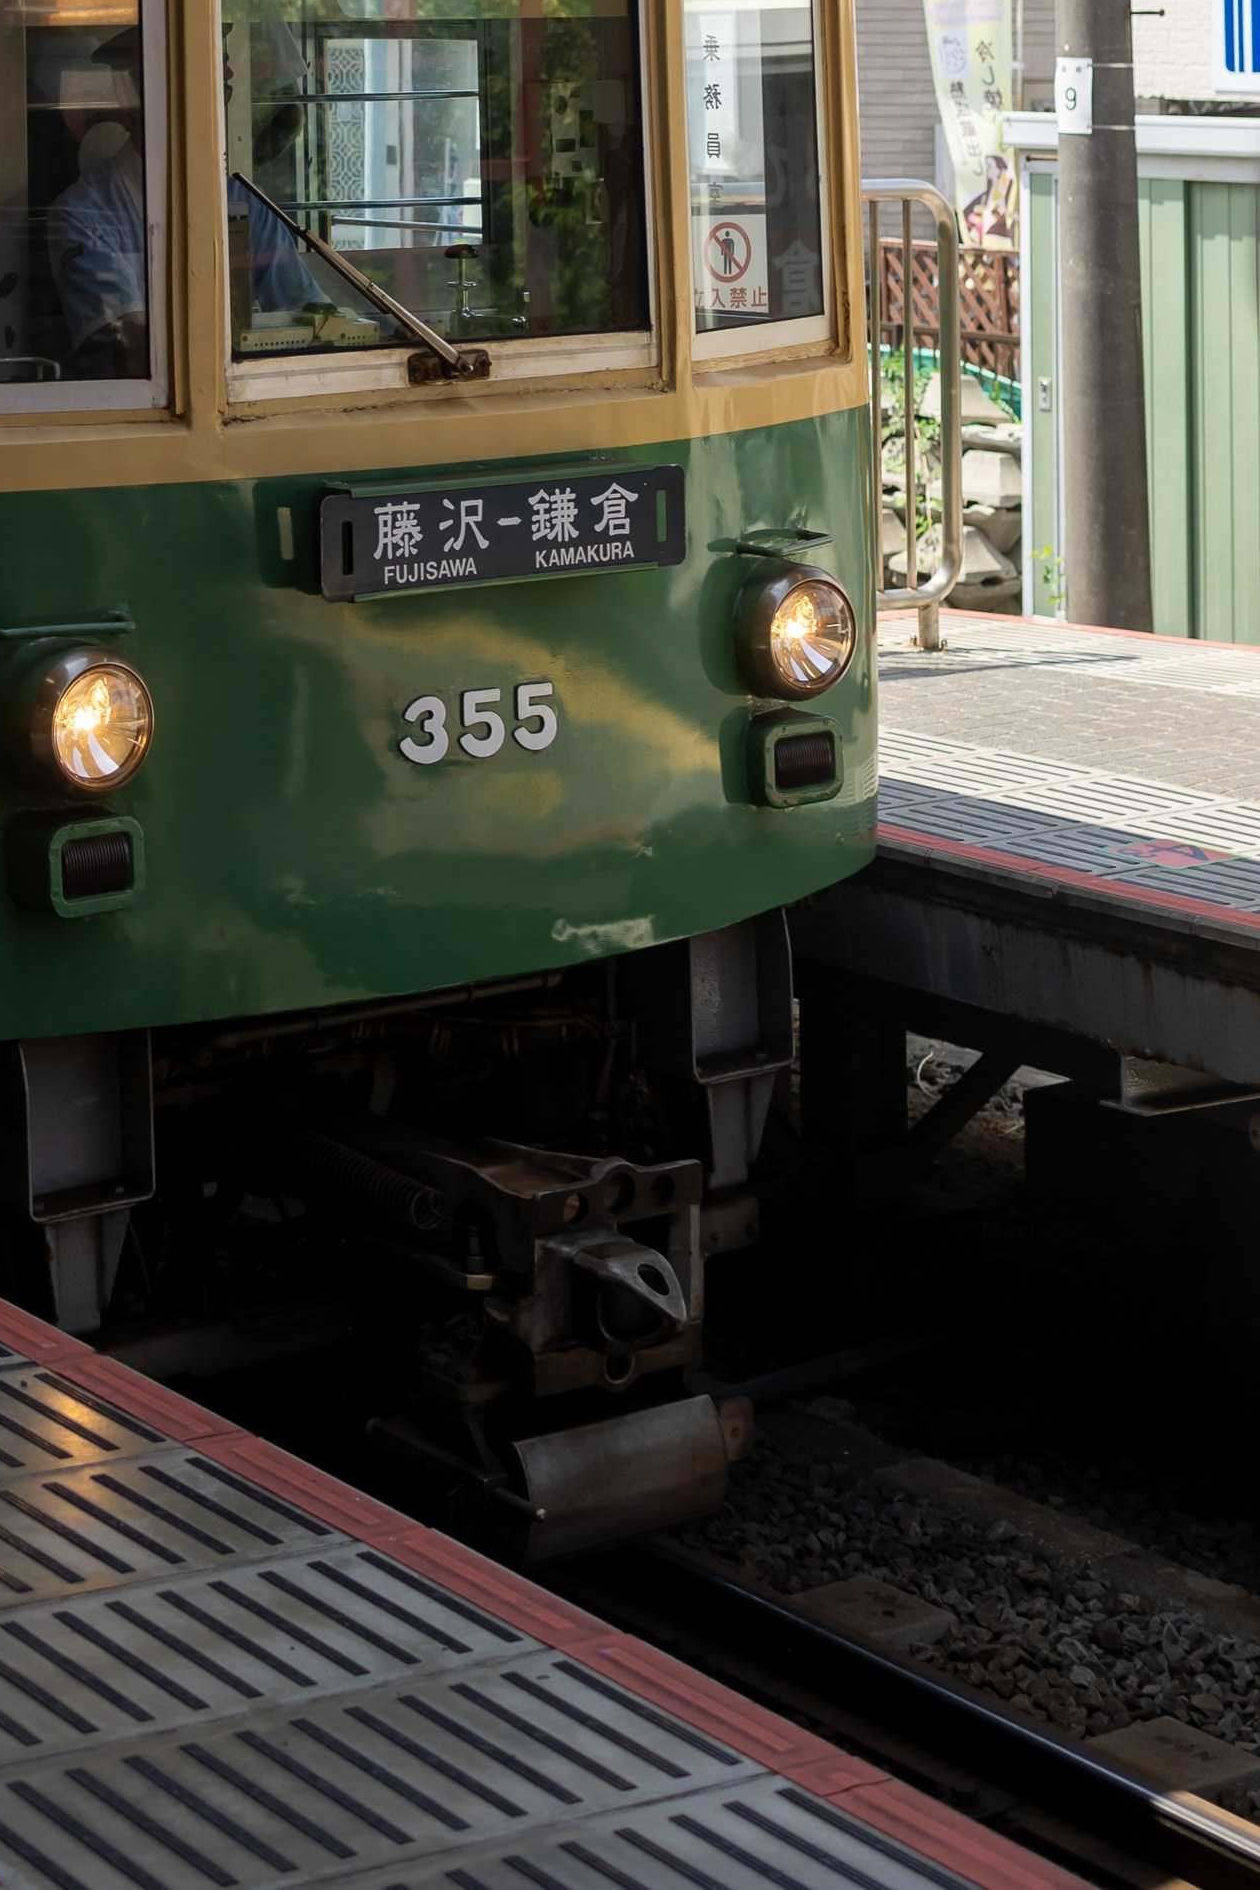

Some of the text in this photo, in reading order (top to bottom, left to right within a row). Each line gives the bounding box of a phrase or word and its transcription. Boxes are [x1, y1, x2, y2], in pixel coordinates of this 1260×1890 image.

[1065, 87, 1077, 111] 9
[384, 541, 635, 585] FUJISAWA KAMAKURA
[399, 681, 558, 765] 355
